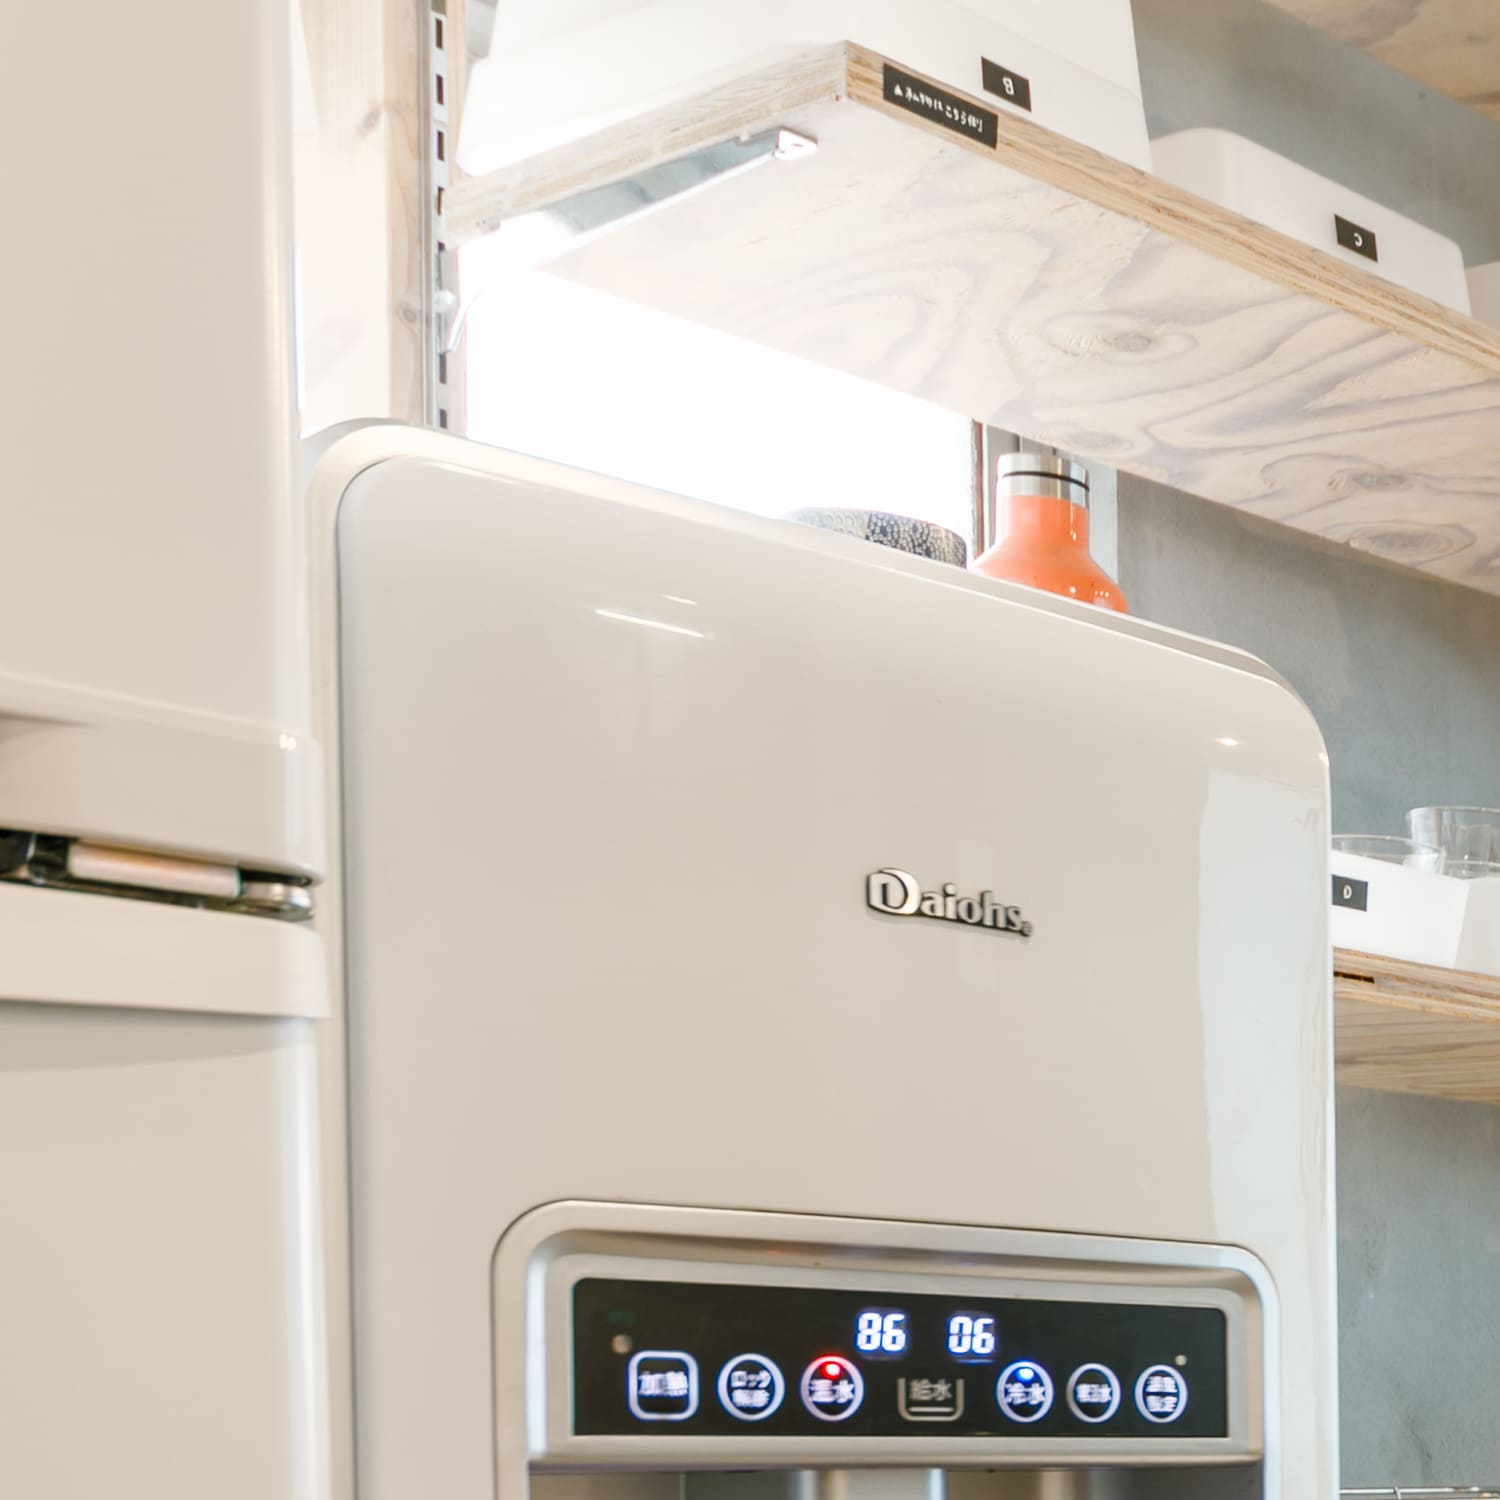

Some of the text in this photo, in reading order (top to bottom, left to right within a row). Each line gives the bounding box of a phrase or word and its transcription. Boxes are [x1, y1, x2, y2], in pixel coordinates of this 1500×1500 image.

[866, 868, 1022, 932] Daiohs
[1343, 885, 1352, 899] D
[857, 1311, 995, 1355] 86 06
[1003, 1382, 1046, 1405] 冷水
